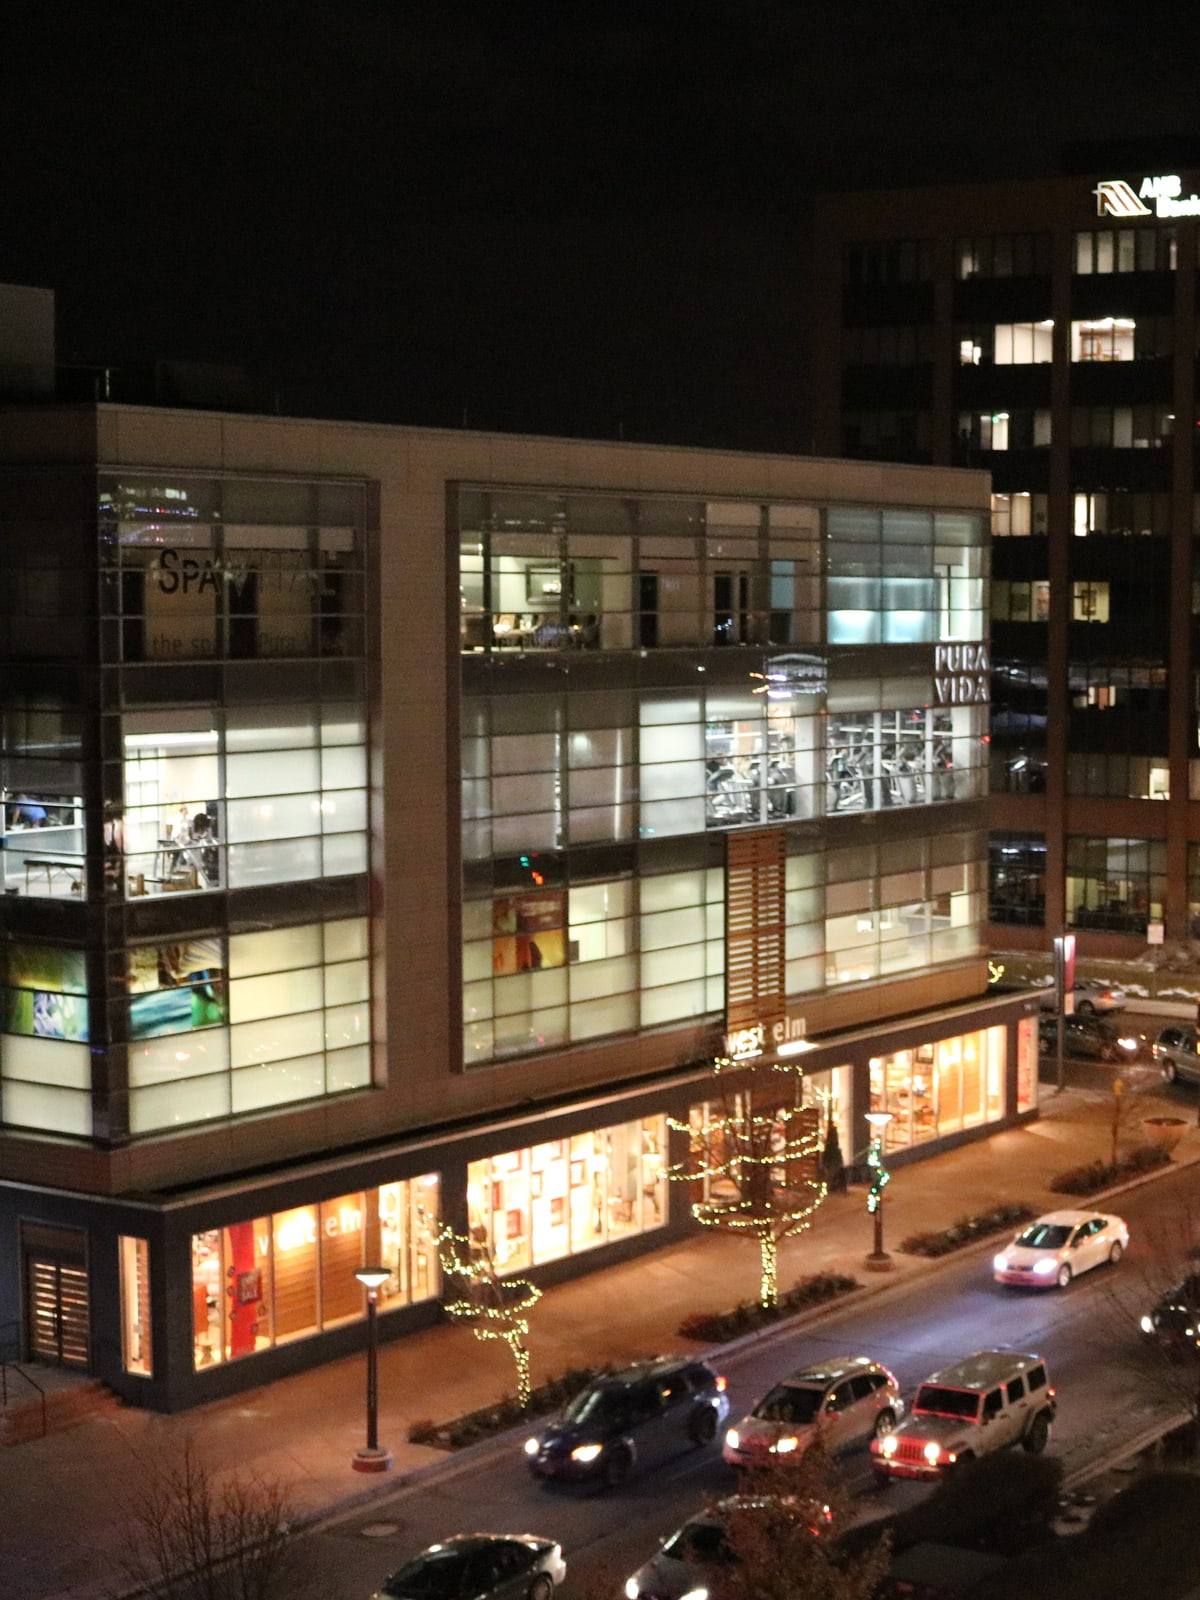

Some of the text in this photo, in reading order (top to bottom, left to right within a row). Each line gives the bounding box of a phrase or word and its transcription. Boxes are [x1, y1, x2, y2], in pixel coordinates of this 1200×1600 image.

[935, 645, 990, 672] PURA
[935, 676, 990, 703] VIDA
[772, 1016, 807, 1041] elm
